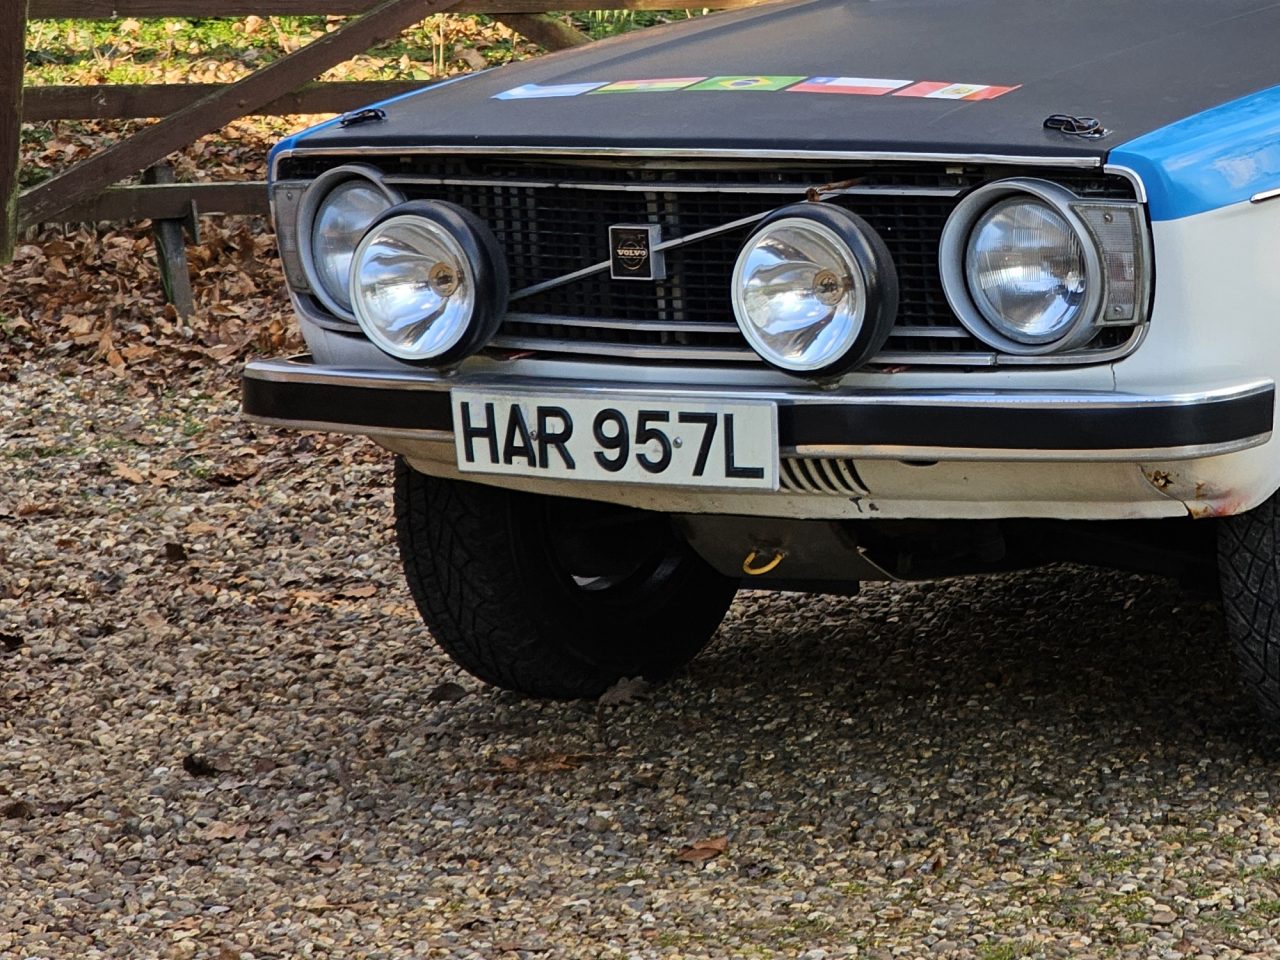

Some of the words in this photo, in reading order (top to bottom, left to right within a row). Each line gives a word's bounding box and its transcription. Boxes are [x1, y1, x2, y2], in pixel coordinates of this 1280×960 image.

[617, 249, 647, 257] VOLVO
[460, 401, 576, 470] HAR
[592, 408, 765, 479] 957L
